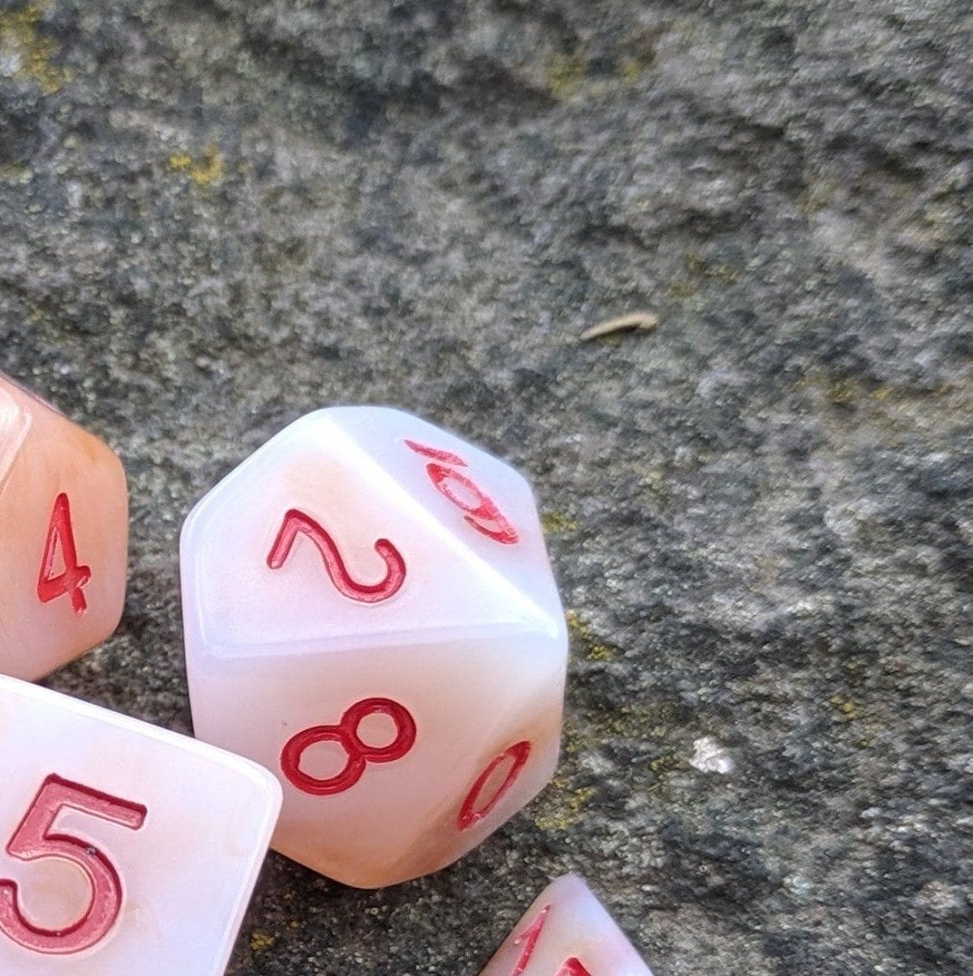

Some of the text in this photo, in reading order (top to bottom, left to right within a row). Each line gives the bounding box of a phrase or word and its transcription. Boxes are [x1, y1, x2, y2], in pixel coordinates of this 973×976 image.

[37, 491, 92, 616] 4
[266, 508, 406, 603] 2
[281, 697, 417, 797] 8
[458, 740, 532, 834] 0
